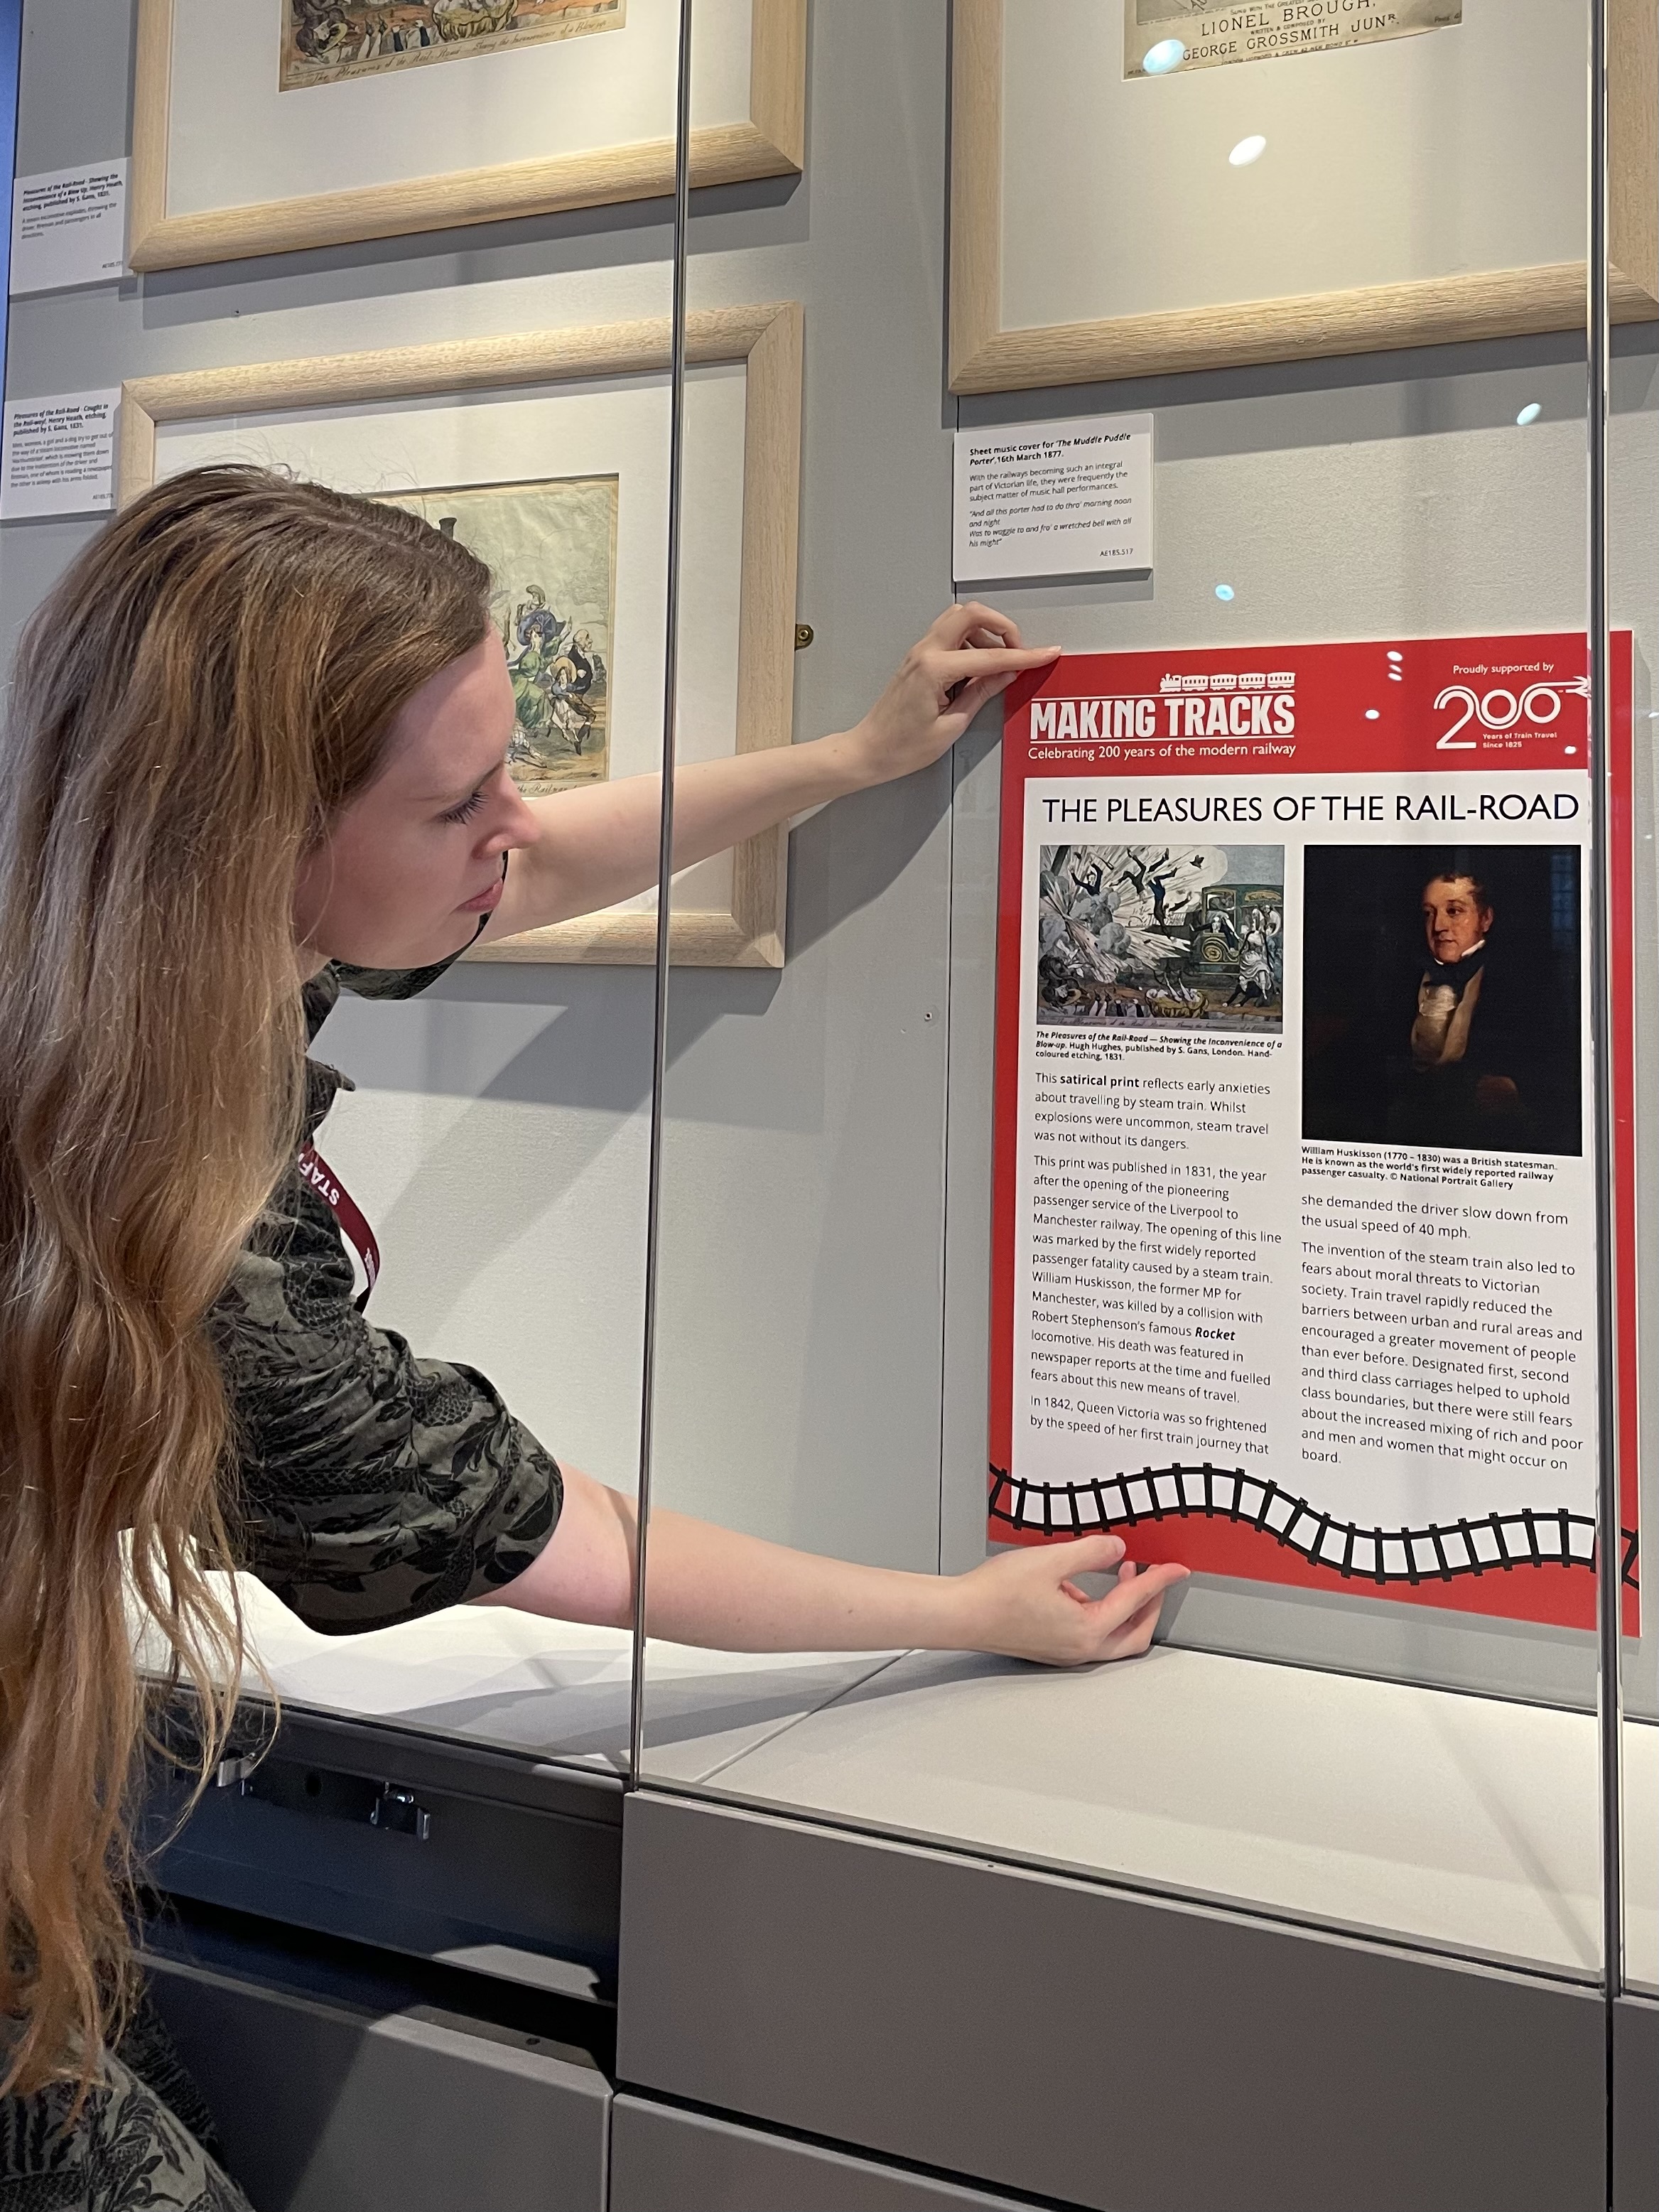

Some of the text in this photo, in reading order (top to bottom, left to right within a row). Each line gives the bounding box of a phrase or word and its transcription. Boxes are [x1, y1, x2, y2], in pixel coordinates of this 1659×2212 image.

[1201, 13, 1270, 36] LIONEL
[1182, 41, 1237, 60] GEORGE
[1246, 23, 1339, 50] GROSSMITH
[970, 448, 992, 456] Sheet
[993, 446, 1017, 454] music
[1018, 443, 1041, 452] cover
[1042, 441, 1054, 449] for
[1073, 436, 1103, 446] Muddle
[1103, 433, 1131, 443] Puddle
[1016, 452, 1042, 462] March
[1044, 450, 1064, 459] 1877.
[1000, 471, 1029, 480] railways
[1030, 468, 1065, 477] becoming
[1066, 465, 1084, 473] such
[1095, 460, 1123, 471] integral
[969, 485, 984, 494] part
[985, 482, 993, 491] of
[993, 480, 1025, 490] Victorian
[1026, 478, 1039, 487] life,
[1040, 478, 1057, 487] they
[1077, 471, 1115, 483] frequently
[1115, 470, 1128, 479] the
[969, 493, 995, 503] subject
[1020, 489, 1029, 497] of
[1029, 488, 1052, 497] music
[1052, 486, 1065, 495] hall
[1066, 482, 1119, 495] performances.
[1453, 662, 1555, 676] Proudly supported by
[1030, 694, 1295, 740] MAKING TRACKS
[1433, 684, 1562, 750] 200
[1028, 742, 1297, 762] Celebrating 200 years of the modern railway
[1042, 794, 1579, 823] THE PLEASURES OF THE RAIL-ROAD
[1035, 1072, 1270, 1095] This satirical print reflects early anxieties
[1034, 1091, 1246, 1113] about travelling by steam train. Whilst
[1034, 1111, 1269, 1135] explosions were uncommon, steam travel
[1034, 1132, 1189, 1152] was not without its dangers.
[1301, 1145, 1334, 1156] William
[1336, 1148, 1382, 1159] Huskisson
[1383, 1151, 1408, 1161] (1770
[1417, 1153, 1441, 1164] 1830)
[1471, 1157, 1502, 1167] British
[1504, 1160, 1558, 1170] statesman.
[1033, 1155, 1268, 1184] This print was published in 1831, the year
[1302, 1156, 1314, 1165] He
[1316, 1157, 1323, 1165] is
[1324, 1157, 1355, 1167] known
[1368, 1160, 1384, 1170] the
[1421, 1164, 1441, 1174] first
[1442, 1166, 1473, 1177] widely
[1474, 1170, 1516, 1179] reported
[1518, 1171, 1554, 1183] railway
[1302, 1168, 1346, 1179] passenger
[1348, 1170, 1388, 1182] casualty.
[1400, 1173, 1439, 1184] National
[1442, 1176, 1478, 1187] Portrait
[1480, 1178, 1513, 1191] Gallery
[1302, 1194, 1568, 1225] she demanded the driver slow down from
